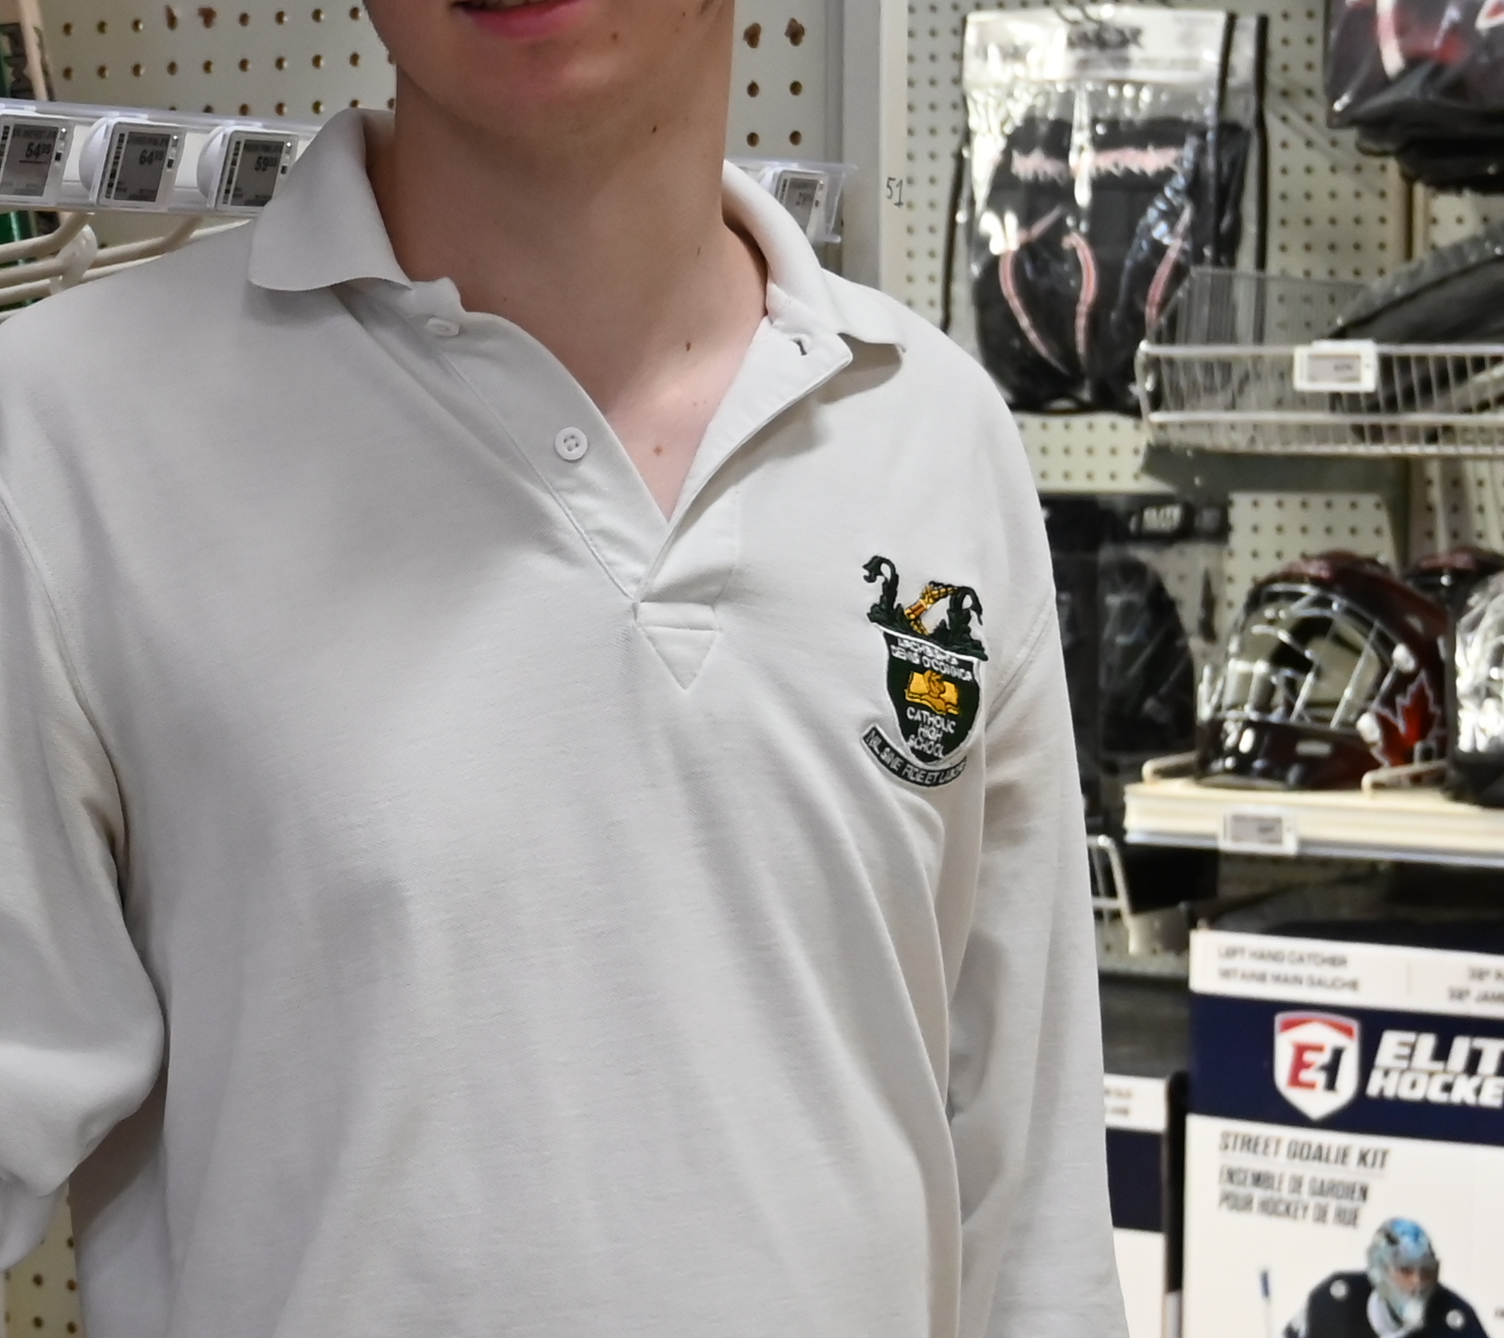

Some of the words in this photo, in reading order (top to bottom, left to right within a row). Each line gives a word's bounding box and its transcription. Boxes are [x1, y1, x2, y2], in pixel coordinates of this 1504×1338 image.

[906, 706, 956, 734] CATHOLIC
[906, 734, 945, 758] SCHOOL
[1219, 1130, 1282, 1158] STREET
[1286, 1135, 1353, 1166] GOALIE
[1357, 1143, 1390, 1170] KIT
